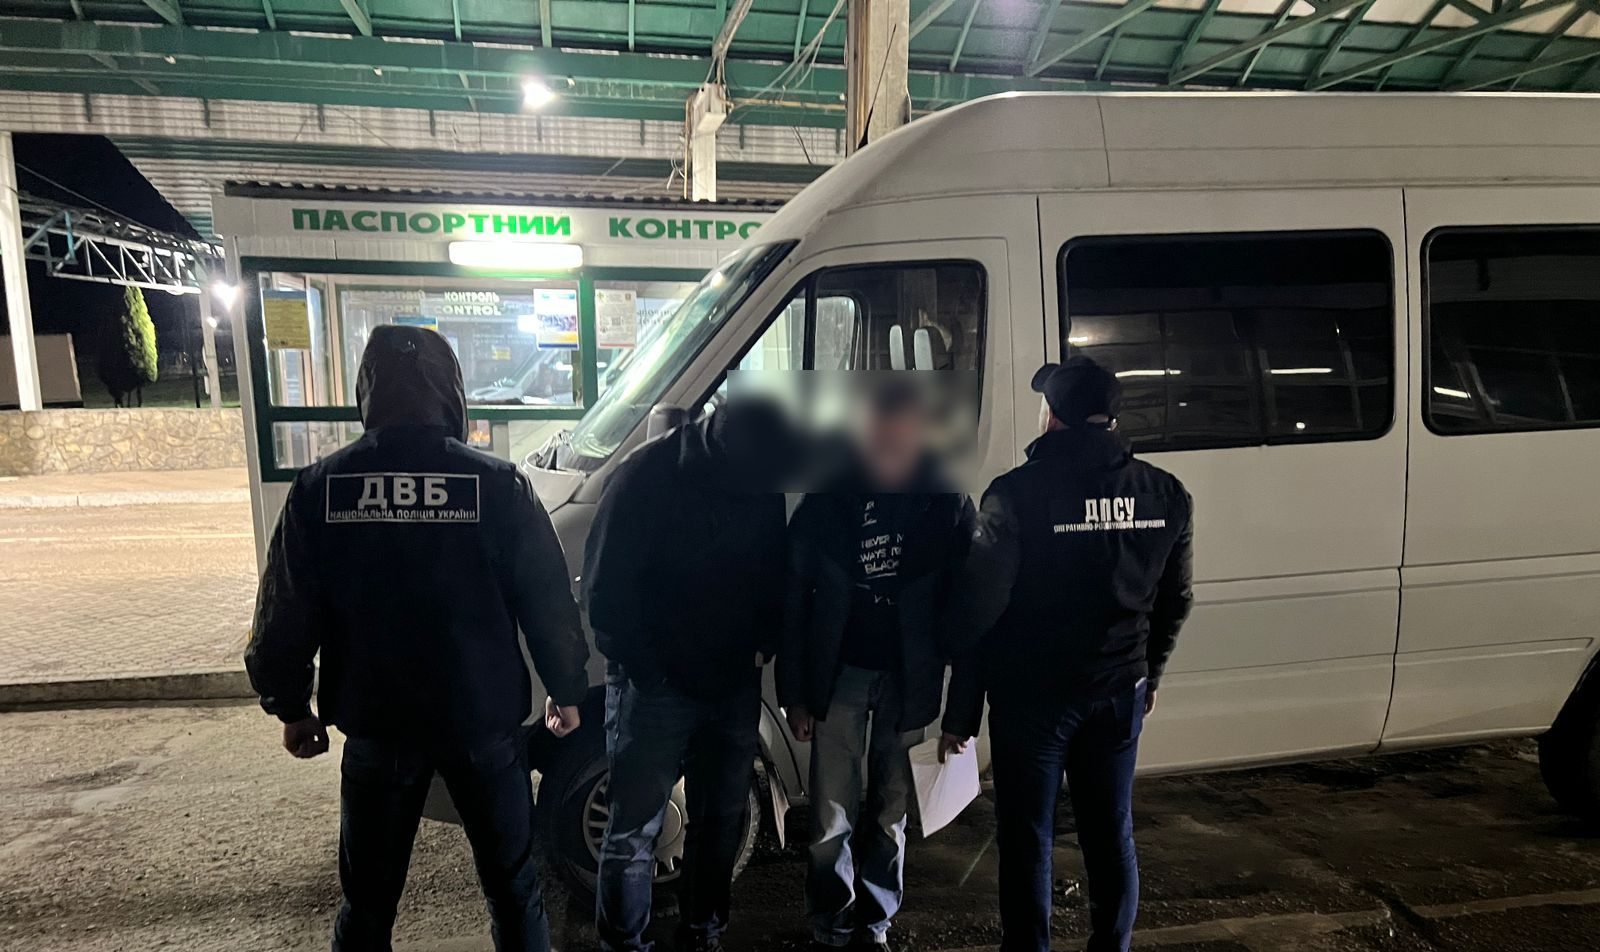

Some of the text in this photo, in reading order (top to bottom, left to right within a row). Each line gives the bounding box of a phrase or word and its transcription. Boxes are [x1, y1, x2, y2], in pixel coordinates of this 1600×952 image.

[444, 291, 500, 303] КОНТРОЛЬ
[434, 304, 502, 317] CONTROL
[357, 476, 449, 510] ДВБ
[330, 508, 476, 520] НАЦІОНАЛЬНА ПОЛІЦІЯ УКРАЇНИ
[1085, 497, 1135, 523] ДПСУ
[859, 548, 887, 563] WAYS
